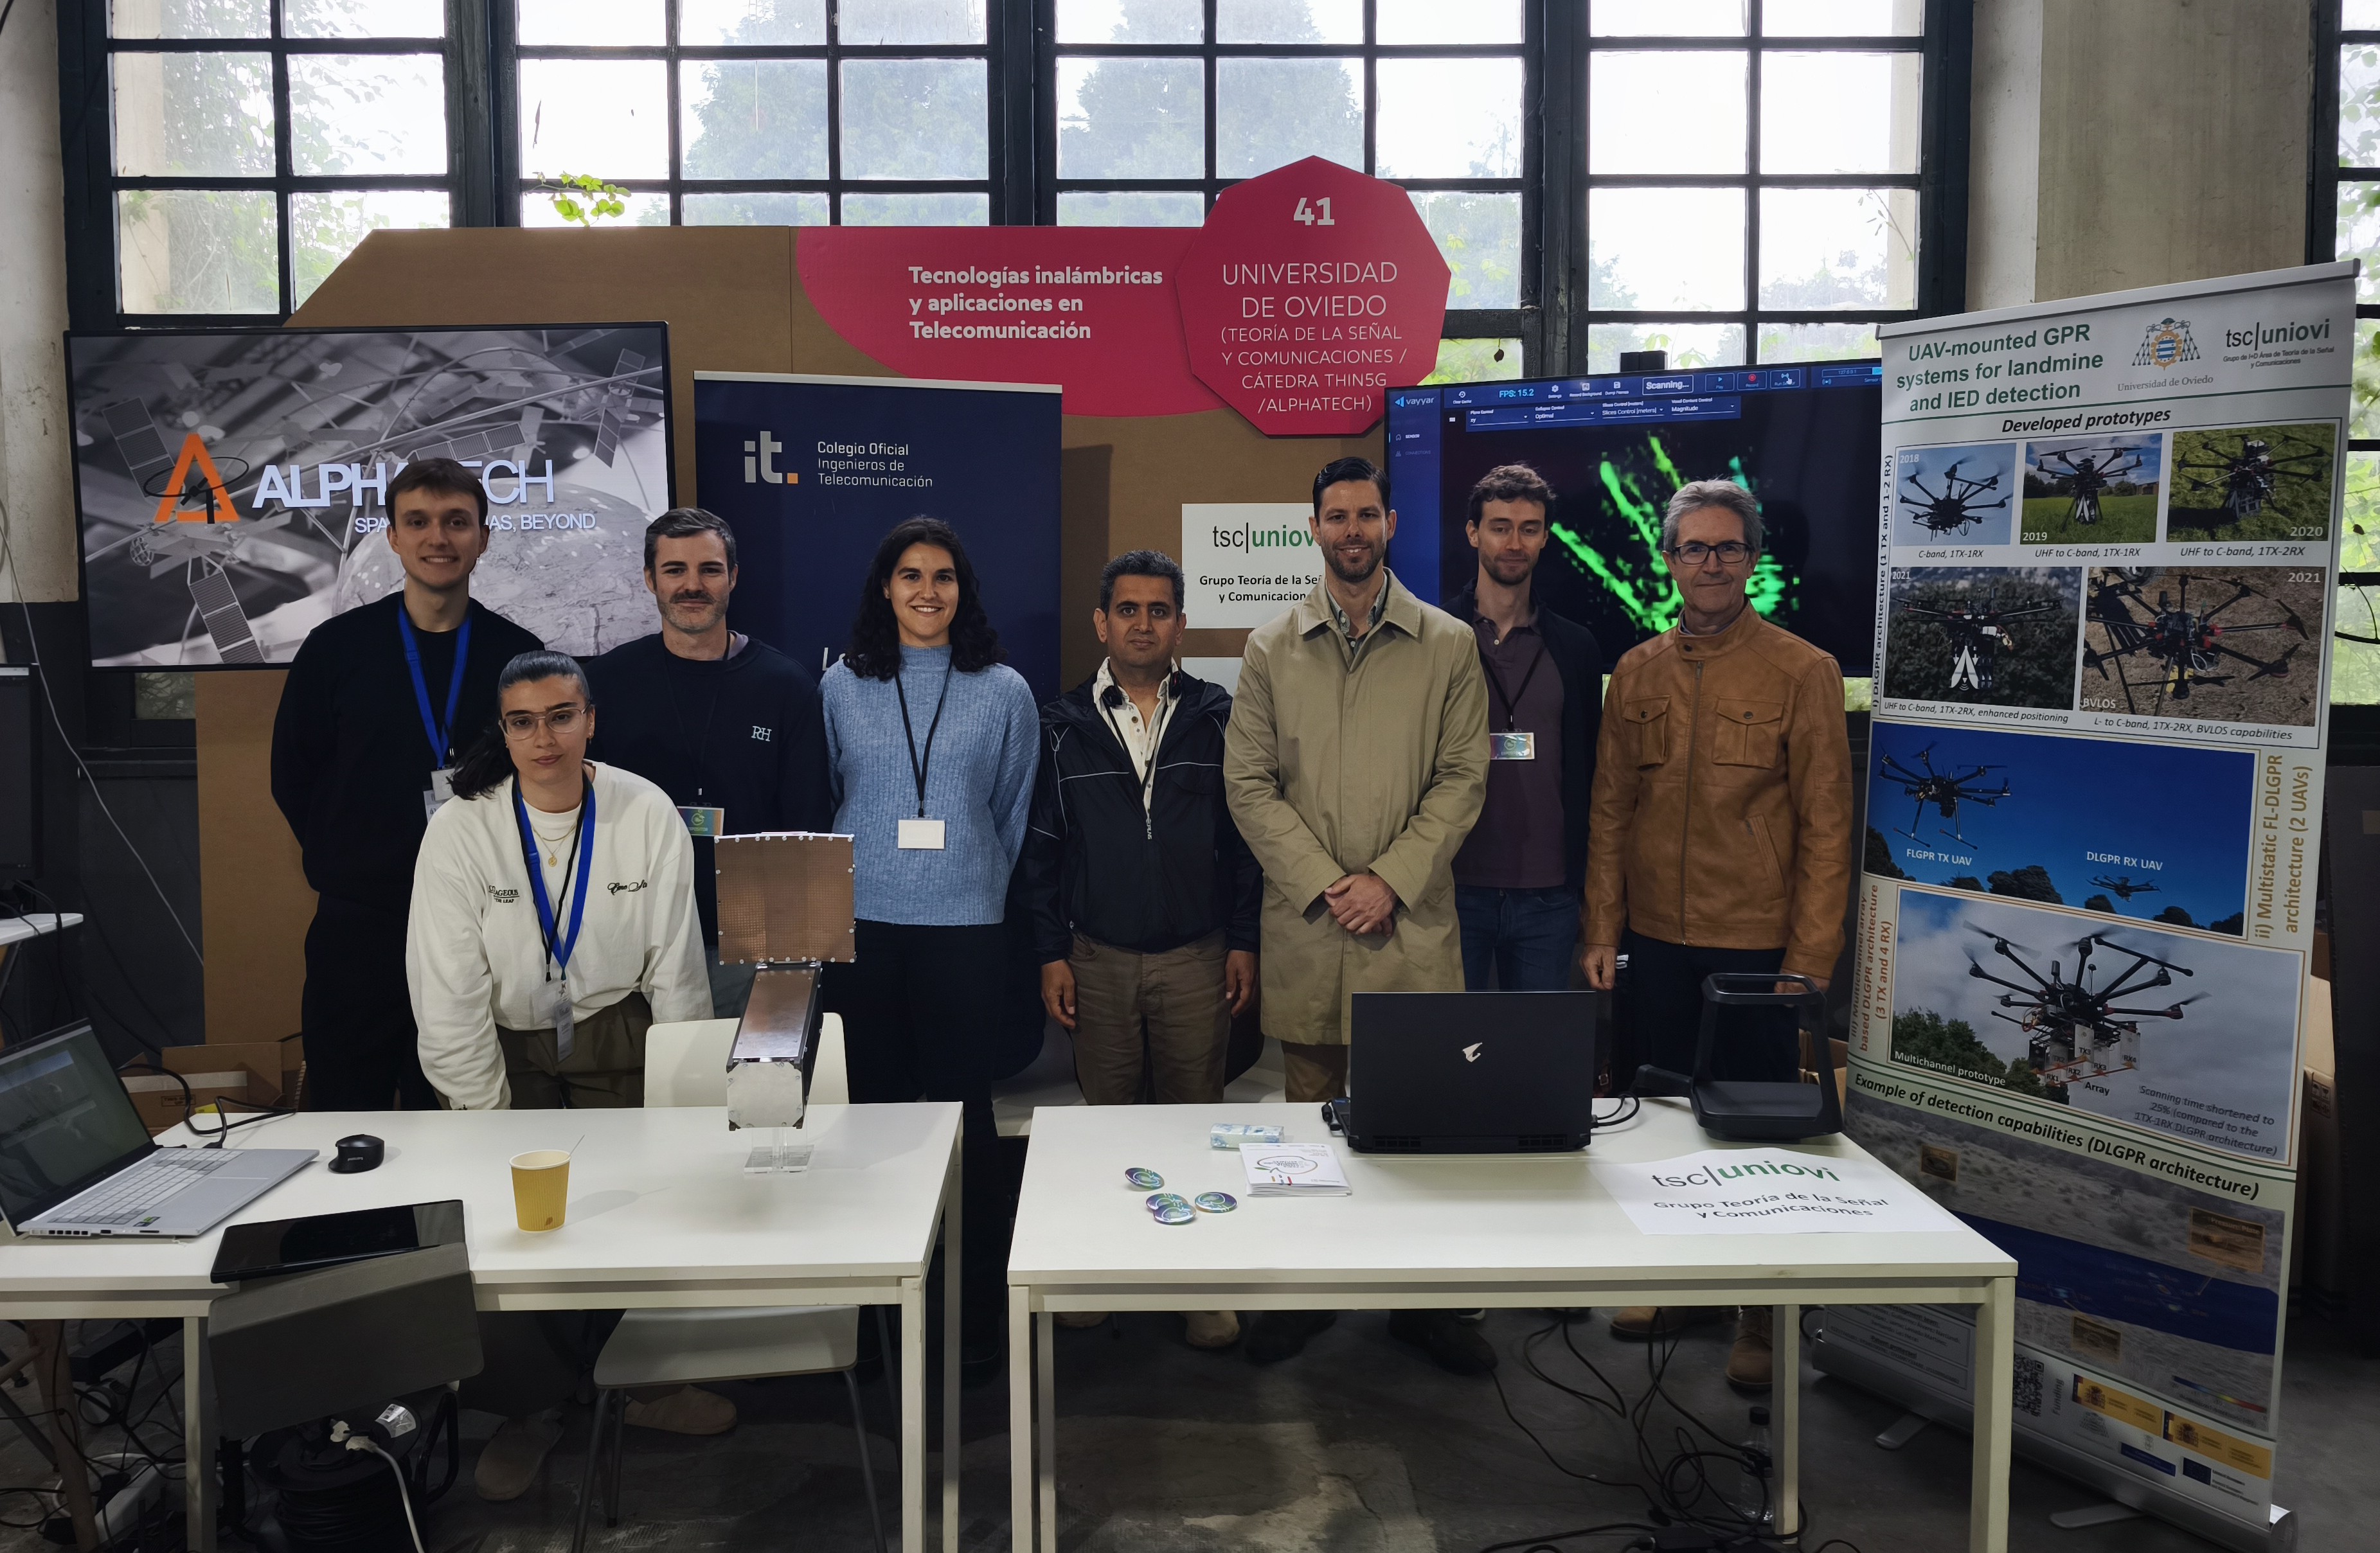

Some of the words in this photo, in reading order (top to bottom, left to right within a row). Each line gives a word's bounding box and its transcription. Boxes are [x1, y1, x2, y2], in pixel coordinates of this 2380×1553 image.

[1293, 197, 1335, 226] 41
[909, 266, 1029, 288] Tecnologías
[1035, 265, 1163, 284] inalámbricas
[1223, 262, 1397, 285] UNIVERSIDAD
[909, 298, 922, 315] y
[928, 292, 1052, 315] aplicaciones
[1059, 299, 1082, 311] en
[1242, 297, 1275, 317] DE
[1285, 295, 1386, 317] OVIEDO
[909, 320, 1091, 339] Telecomunicación
[1221, 324, 1289, 344] (TEORÍA
[1295, 327, 1316, 341] DE
[1322, 326, 1342, 341] LA
[1348, 323, 1402, 340] SEÑAL
[1909, 331, 2036, 361] UAV-mounted
[2043, 324, 2090, 346] GPR
[1222, 352, 1232, 366] Y
[1238, 350, 1393, 366] COMUNICACIONES
[1399, 348, 1407, 364] /
[1242, 372, 1319, 389] CÁTEDRA
[1324, 373, 1386, 387] THIN5G
[1897, 368, 1969, 391] systems
[1976, 363, 2002, 379] for
[2009, 353, 2103, 376] landmine
[2118, 379, 2167, 391] Universidad
[2169, 378, 2179, 387] de
[2181, 375, 2214, 386] Oviedo
[1258, 396, 1372, 413] /ALPHATECH)
[1406, 396, 1435, 405] vayyar
[1910, 393, 1941, 412] and
[1948, 389, 1980, 408] IED
[1985, 383, 2080, 404] detection
[2002, 414, 2083, 433] Developed
[2085, 410, 2170, 432] prototypes
[818, 441, 865, 457] Colegio
[870, 443, 908, 456] Oficial
[818, 458, 885, 472] Ingenieros
[890, 459, 904, 471] de
[1884, 455, 1893, 477] RX)
[1899, 454, 1919, 464] 2018
[818, 473, 932, 487] Telecomunicación
[521, 513, 596, 530] BEYOND
[2023, 532, 2047, 541] 2019
[2290, 526, 2323, 537] 2020
[1881, 534, 1888, 549] TX
[1919, 550, 1947, 560] C-band,
[2035, 549, 2053, 558] UHF
[2066, 548, 2099, 559] C-band,
[2103, 548, 2140, 556] 1TX-1RX
[2180, 547, 2201, 556] UHF
[2204, 548, 2214, 556] to
[2216, 546, 2255, 558] C-band,
[2258, 546, 2305, 556] 1TX-2RX
[1199, 576, 1234, 587] Grupo
[1238, 575, 1271, 585] Teoría
[1275, 575, 1288, 585] de
[1293, 575, 1302, 585] la
[1892, 571, 1911, 580] 2021
[2287, 572, 2322, 583] 2021
[1219, 593, 1224, 603] y
[1877, 570, 1886, 648] architecture
[2082, 698, 2116, 709] BVLOS
[1884, 702, 1898, 710] UHF
[1908, 704, 1937, 714] C-band,
[1940, 706, 1975, 717] 1TX-2RX,
[1978, 709, 2019, 719] enhanced
[2021, 712, 2068, 724] positioning
[2116, 718, 2150, 731] C-band,
[2153, 721, 2193, 734] 1TX-2RX,
[2197, 725, 2228, 735] BVLOS
[2230, 728, 2293, 740] capabilities
[2263, 755, 2282, 830] FL-DLGPR
[2291, 766, 2313, 812] UAVs)
[2288, 817, 2309, 832] (2
[1906, 849, 1935, 861] FLGPR
[1937, 853, 1949, 864] TX
[1951, 855, 1972, 866] UAV
[2086, 851, 2120, 864] DLGPR
[2124, 856, 2137, 867] RX
[2141, 859, 2163, 871] UAV
[2257, 835, 2278, 919] Multistatic
[2283, 838, 2305, 934] architecture
[1866, 885, 1878, 963] architecture
[1881, 921, 1893, 943] RX)
[2255, 923, 2274, 939] ii)
[1880, 946, 1888, 955] 4
[1878, 957, 1888, 983] and
[1863, 966, 1873, 1009] DLGPR
[1877, 986, 1886, 1002] TX
[1875, 1006, 1887, 1019] (3
[1859, 1013, 1870, 1052] based
[1895, 1051, 1955, 1074] Multichannel
[1958, 1067, 2006, 1086] prototype
[2085, 1082, 2110, 1096] Array
[2140, 1086, 2181, 1105] Scanning
[2184, 1098, 2205, 1110] time
[2207, 1104, 2260, 1123] shortened
[2262, 1116, 2275, 1125] to
[2150, 1103, 2170, 1114] 25%
[2173, 1108, 2224, 1129] (compared
[2226, 1123, 2237, 1132] to
[2241, 1126, 2259, 1137] the
[1856, 1073, 1906, 1098] Example
[1910, 1090, 1926, 1105] of
[1928, 1094, 1994, 1122] detection
[1998, 1114, 2083, 1147] capabilities
[2088, 1136, 2145, 1165] (DLGPR
[2149, 1155, 2259, 1201] architecture)
[2174, 1123, 2206, 1138] DLGPR
[2208, 1134, 2277, 1157] architecture)
[1653, 1202, 1715, 1210] Grupo
[1721, 1195, 1780, 1209] Teoría
[1785, 1192, 1809, 1201] de
[1812, 1194, 1832, 1203] la
[1838, 1196, 1889, 1207] Señal
[1713, 1204, 1874, 1218] Comunicaciones
